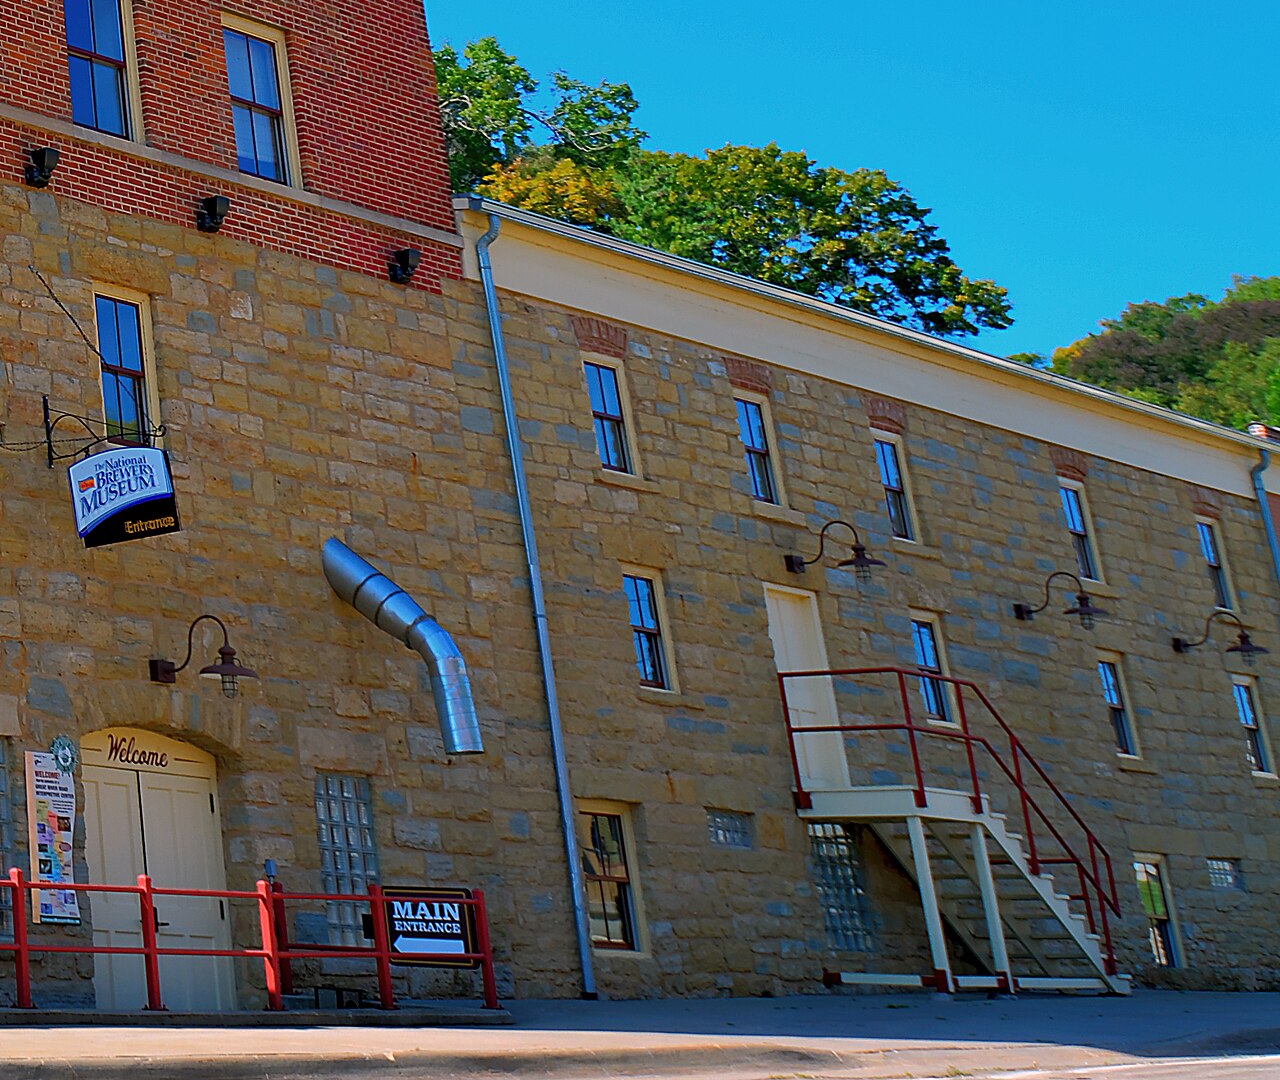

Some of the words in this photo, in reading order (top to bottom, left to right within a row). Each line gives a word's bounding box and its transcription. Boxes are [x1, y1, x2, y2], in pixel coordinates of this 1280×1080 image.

[95, 463, 105, 472] The
[105, 455, 147, 470] National
[95, 464, 154, 489] BREWERY
[80, 475, 157, 519] MUSEUM
[124, 516, 175, 534] Entrance
[107, 734, 169, 768] Welcome
[392, 901, 460, 921] MAIN
[394, 920, 462, 934] ENTRANCE
